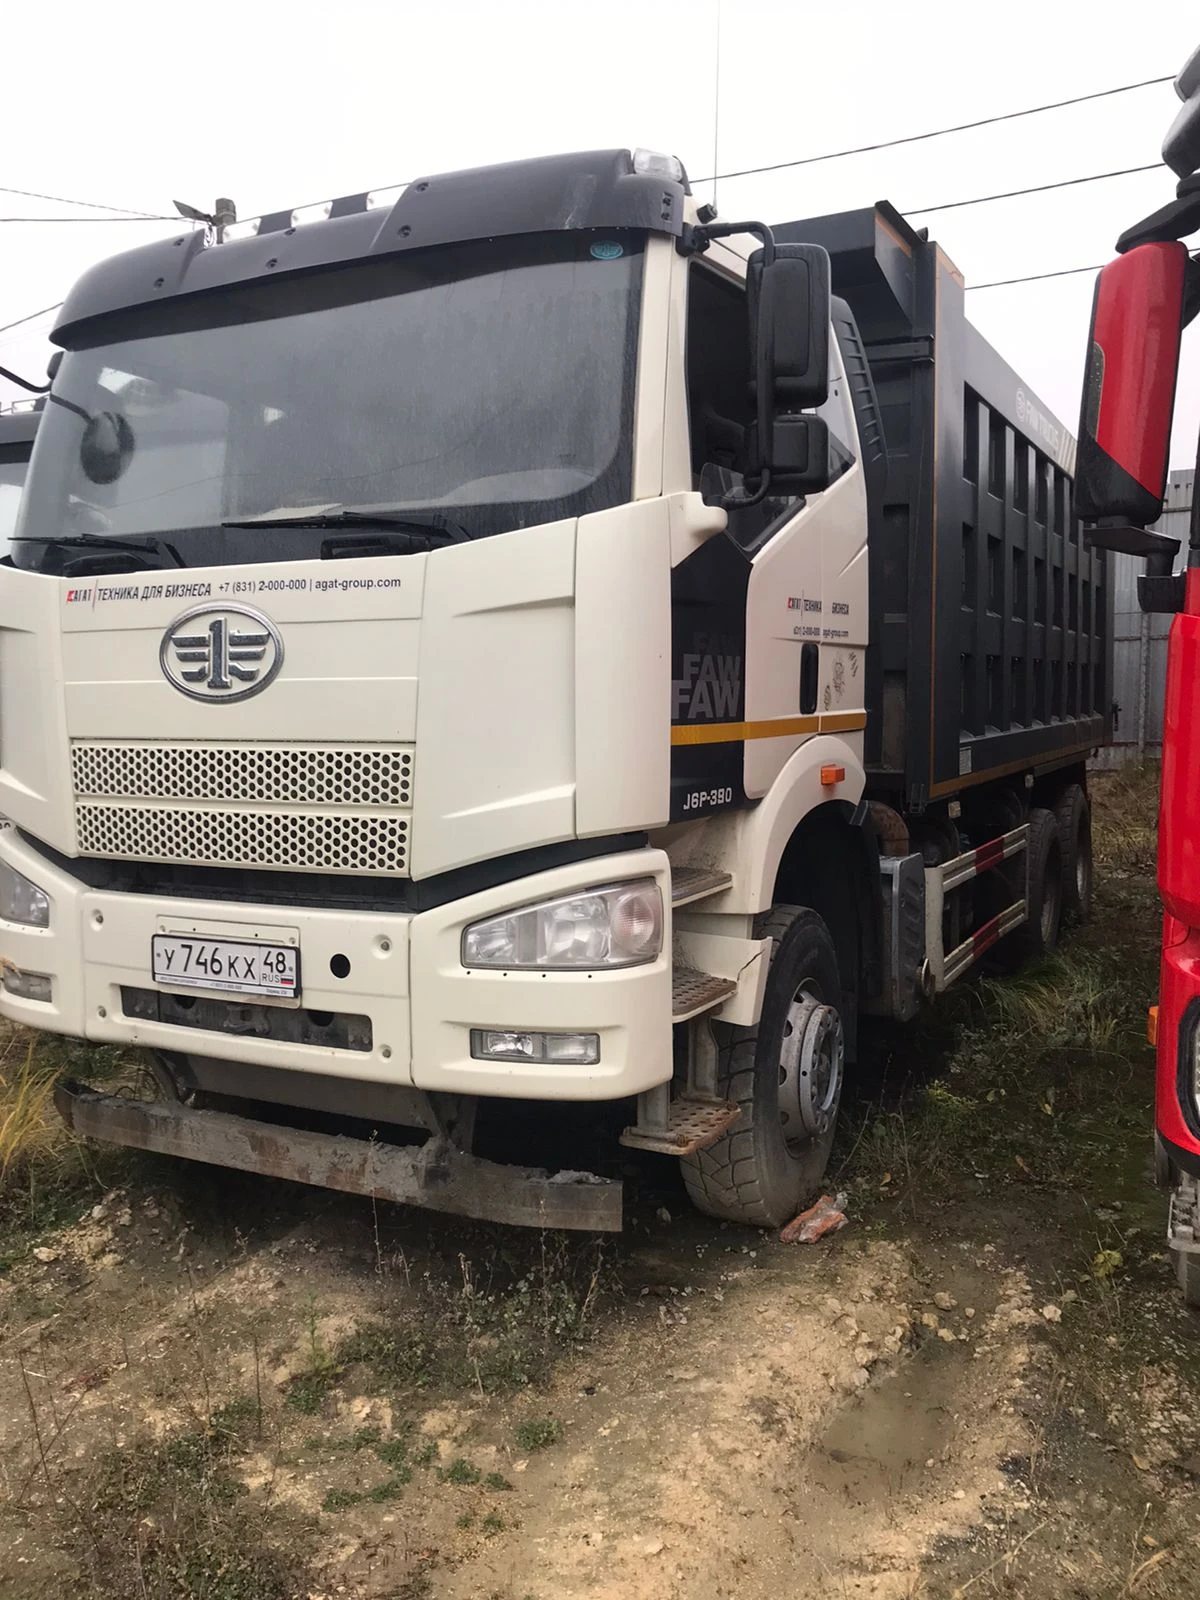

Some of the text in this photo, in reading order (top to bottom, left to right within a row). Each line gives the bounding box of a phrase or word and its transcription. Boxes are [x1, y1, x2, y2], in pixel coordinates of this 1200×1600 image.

[74, 589, 92, 602] АГАТ
[97, 587, 139, 601] ТЕХНИКА
[141, 585, 163, 602] ДЛЯ
[165, 583, 212, 598] БИЗНЕСА
[218, 582, 230, 592] +7
[232, 581, 256, 594] (831)
[259, 579, 307, 591] 2-000-000
[315, 577, 401, 592] agat-group.com
[683, 653, 741, 682] FAW
[671, 679, 741, 719] FAW
[683, 787, 732, 810] J6P-390
[263, 950, 287, 974] 48
[262, 973, 280, 984] RUS
